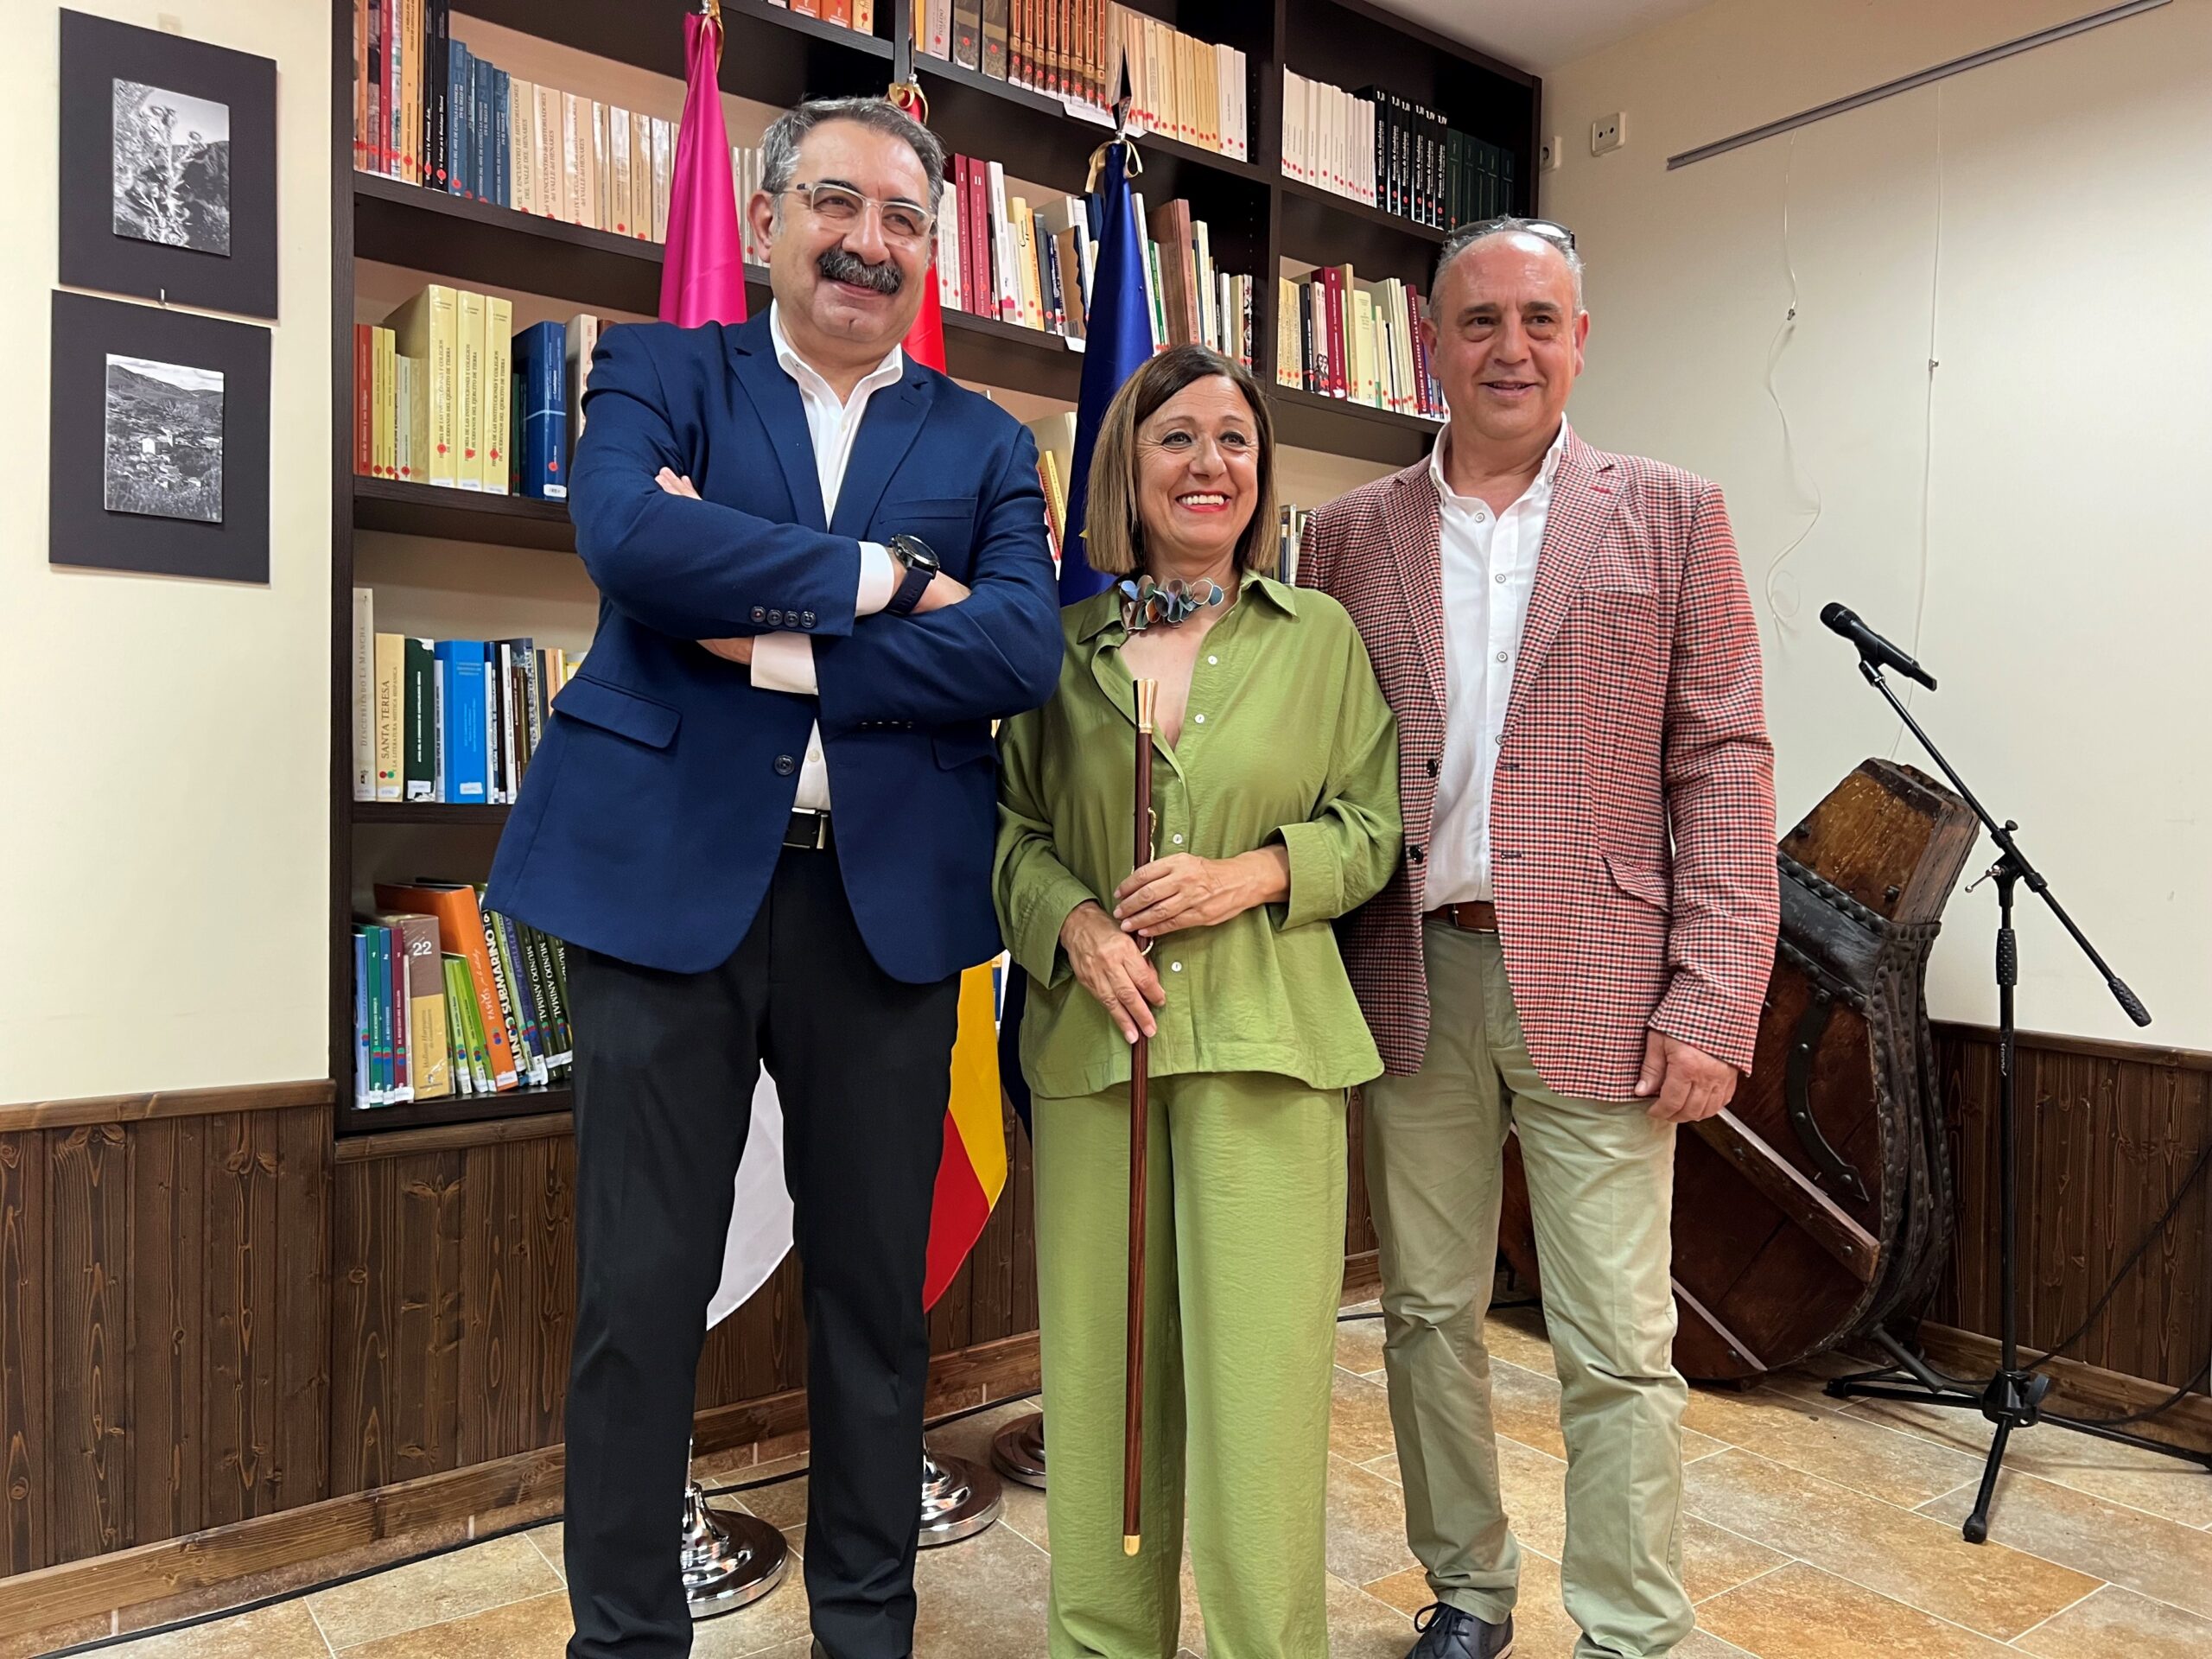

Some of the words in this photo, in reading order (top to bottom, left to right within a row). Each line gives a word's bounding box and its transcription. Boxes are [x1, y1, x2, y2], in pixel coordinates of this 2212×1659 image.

[515, 137, 521, 146] DE
[359, 666, 366, 678] LA
[381, 680, 390, 721] TERESA
[381, 723, 390, 760] SANTA
[392, 759, 397, 767] LA
[484, 913, 490, 923] 6
[412, 941, 432, 956] 22
[484, 928, 513, 1015] SUBMARINO
[525, 945, 539, 982] MUNDO
[533, 982, 548, 1022] ANIMAL
[539, 942, 553, 979] MUNDO
[547, 979, 562, 1019] ANIMAL
